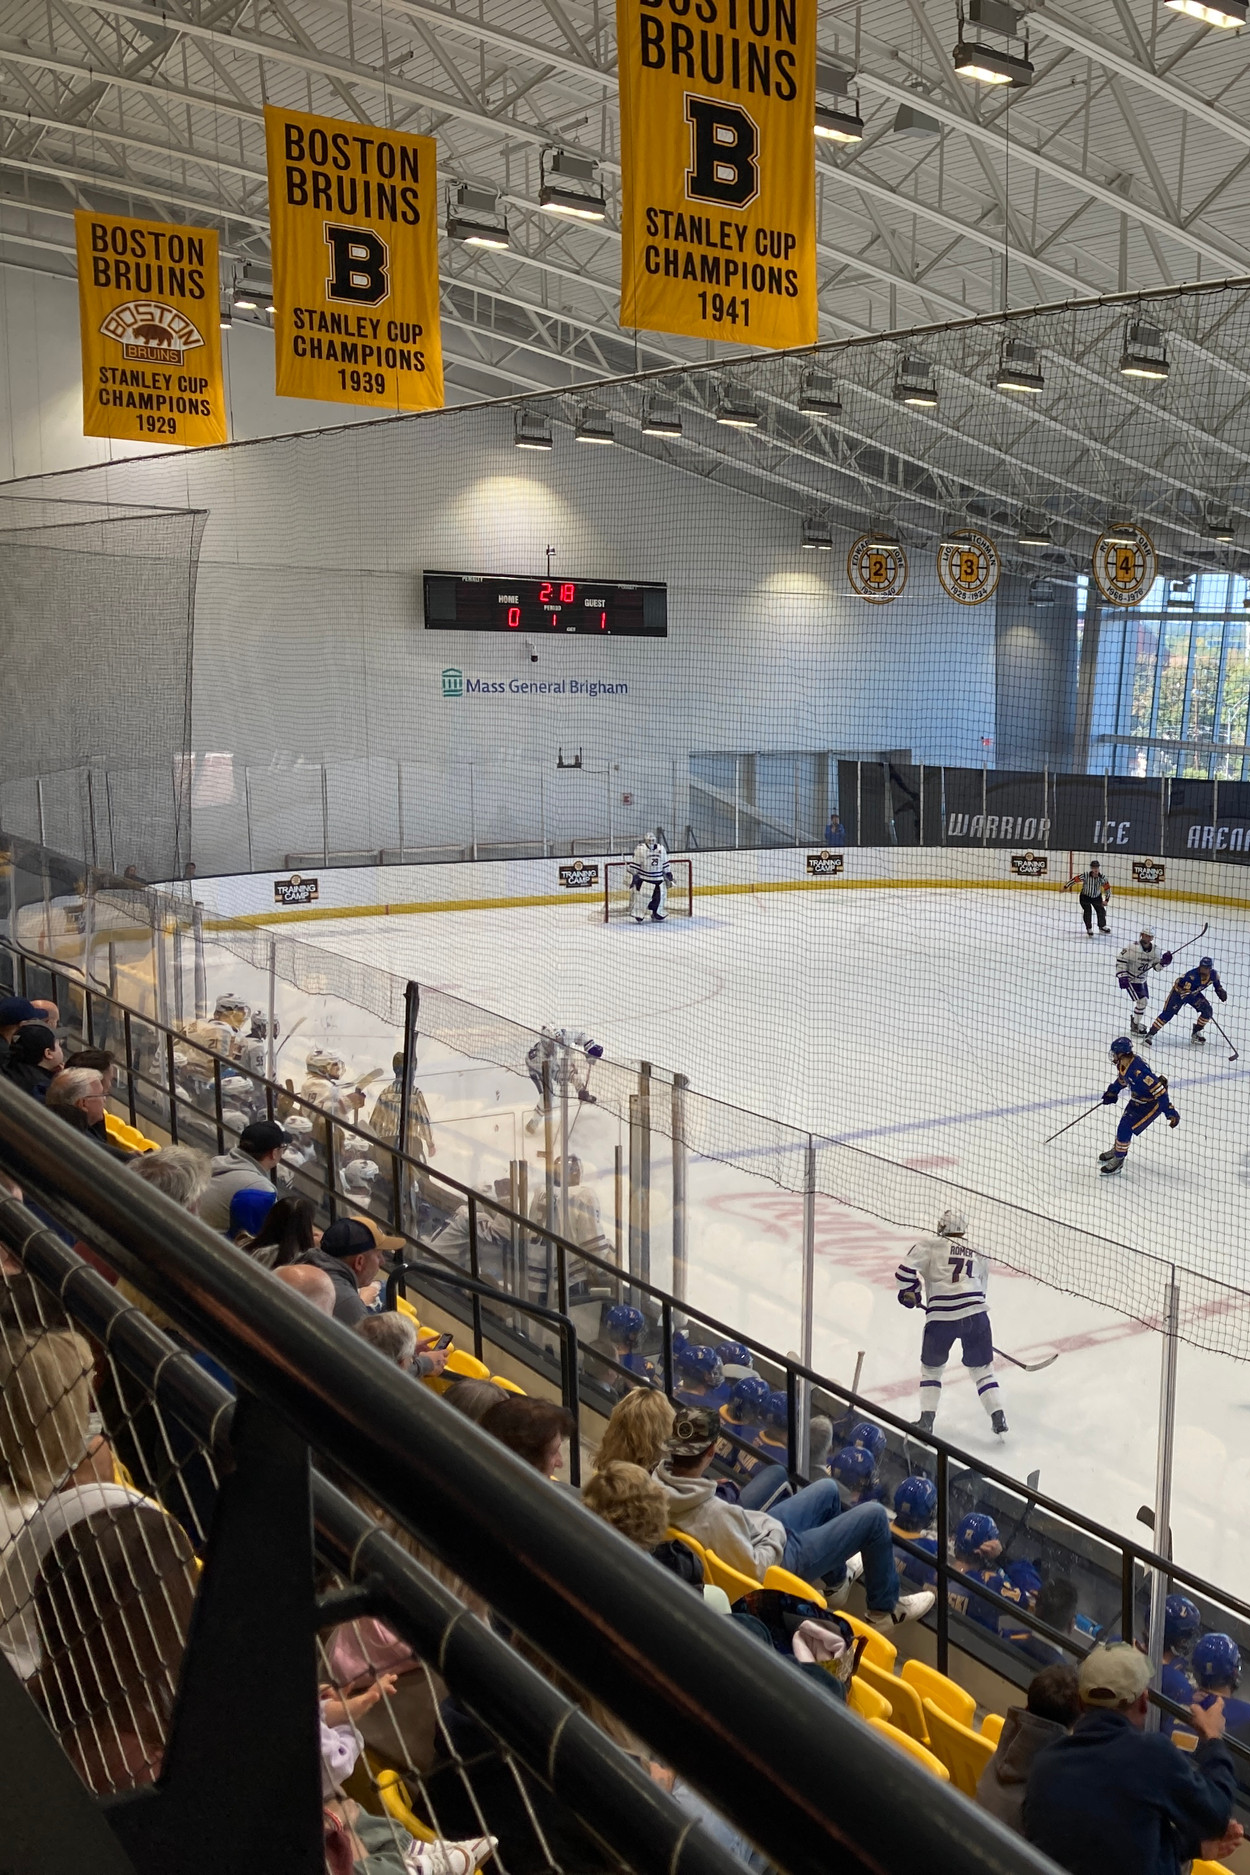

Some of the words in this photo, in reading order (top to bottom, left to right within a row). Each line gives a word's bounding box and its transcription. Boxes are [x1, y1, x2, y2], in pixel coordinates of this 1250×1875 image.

[640, 12, 797, 101] BRUINS
[285, 123, 419, 184] BOSTON
[683, 91, 760, 211] B
[286, 166, 421, 225] BRUINS
[91, 223, 204, 267] BOSTON
[646, 207, 748, 252] STANLEY
[755, 227, 796, 260] CUP
[93, 256, 205, 300] BRUINS
[323, 221, 390, 308] B
[645, 245, 798, 298] CHAMPIONS
[698, 291, 750, 327] 1941
[104, 303, 201, 346] BOSTON
[293, 307, 381, 339] STANLEY
[387, 320, 423, 345] CUP
[128, 346, 178, 362] BRUINS
[293, 335, 425, 372] CHAMPIONS
[99, 367, 172, 391] STANLEY
[178, 375, 208, 394] CUP
[338, 368, 385, 395] 1939
[100, 388, 210, 416] CHAMPIONS
[136, 414, 177, 435] 1929
[1139, 537, 1152, 556] ORR
[873, 561, 883, 576] 2
[964, 559, 974, 576] 3
[1120, 556, 1131, 575] 4
[498, 595, 519, 604] HOME
[540, 583, 575, 602] 2:18
[584, 599, 606, 608] GUEST
[508, 607, 520, 627] 0
[466, 679, 505, 694] Mass
[509, 679, 565, 694] General
[570, 679, 628, 697] Brigham
[948, 813, 1051, 840] WARRIOR
[1093, 820, 1131, 845] ICE
[561, 870, 596, 878] TRAINING
[277, 885, 316, 894] TRAINING
[285, 892, 309, 900] CAMP
[950, 1245, 974, 1258] ROMER
[948, 1257, 974, 1284] 71
